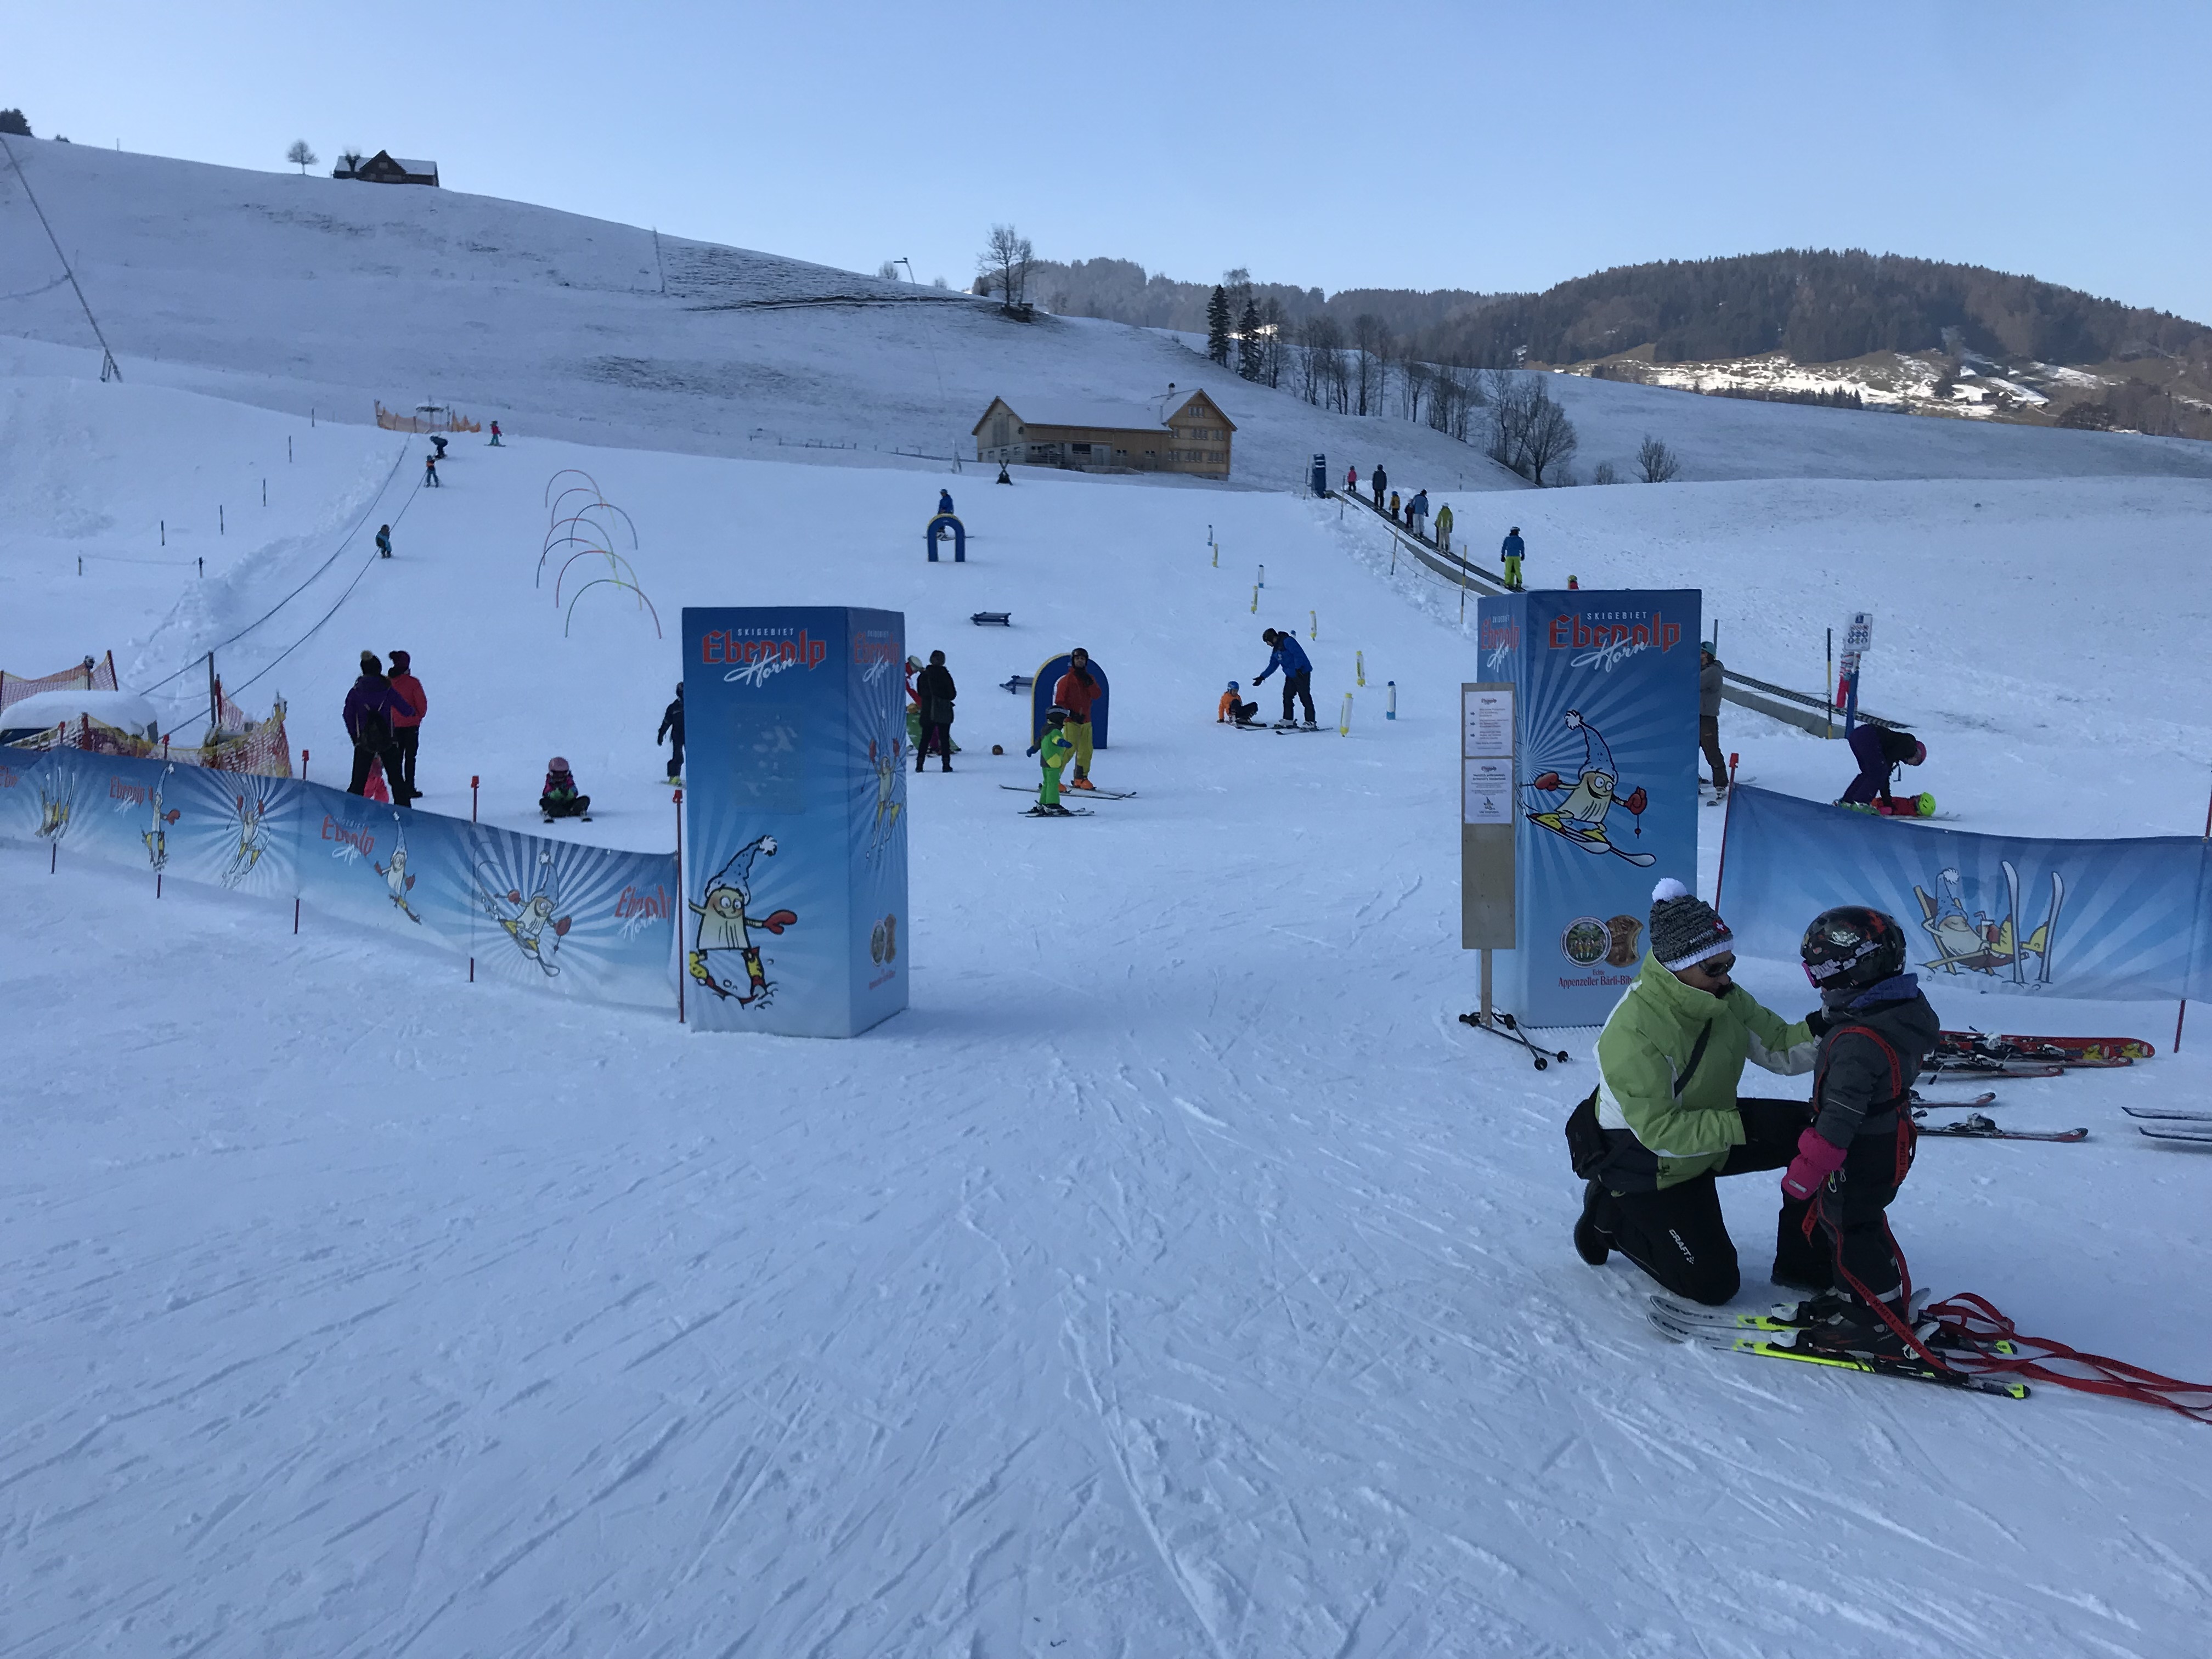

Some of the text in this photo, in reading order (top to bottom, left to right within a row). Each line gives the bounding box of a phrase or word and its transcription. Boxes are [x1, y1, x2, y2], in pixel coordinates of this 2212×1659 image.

[737, 628, 794, 636] SKIGEBIET
[1549, 611, 1681, 654] Ebenalp
[1587, 612, 1647, 620] SKIGEBIET
[702, 628, 826, 672] Ebenalp
[1570, 633, 1649, 673] Horn
[724, 649, 796, 688] Horn
[1559, 975, 1633, 989] Appenzeller Bärli-Bib
[1669, 1229, 1691, 1256] CRAFT
